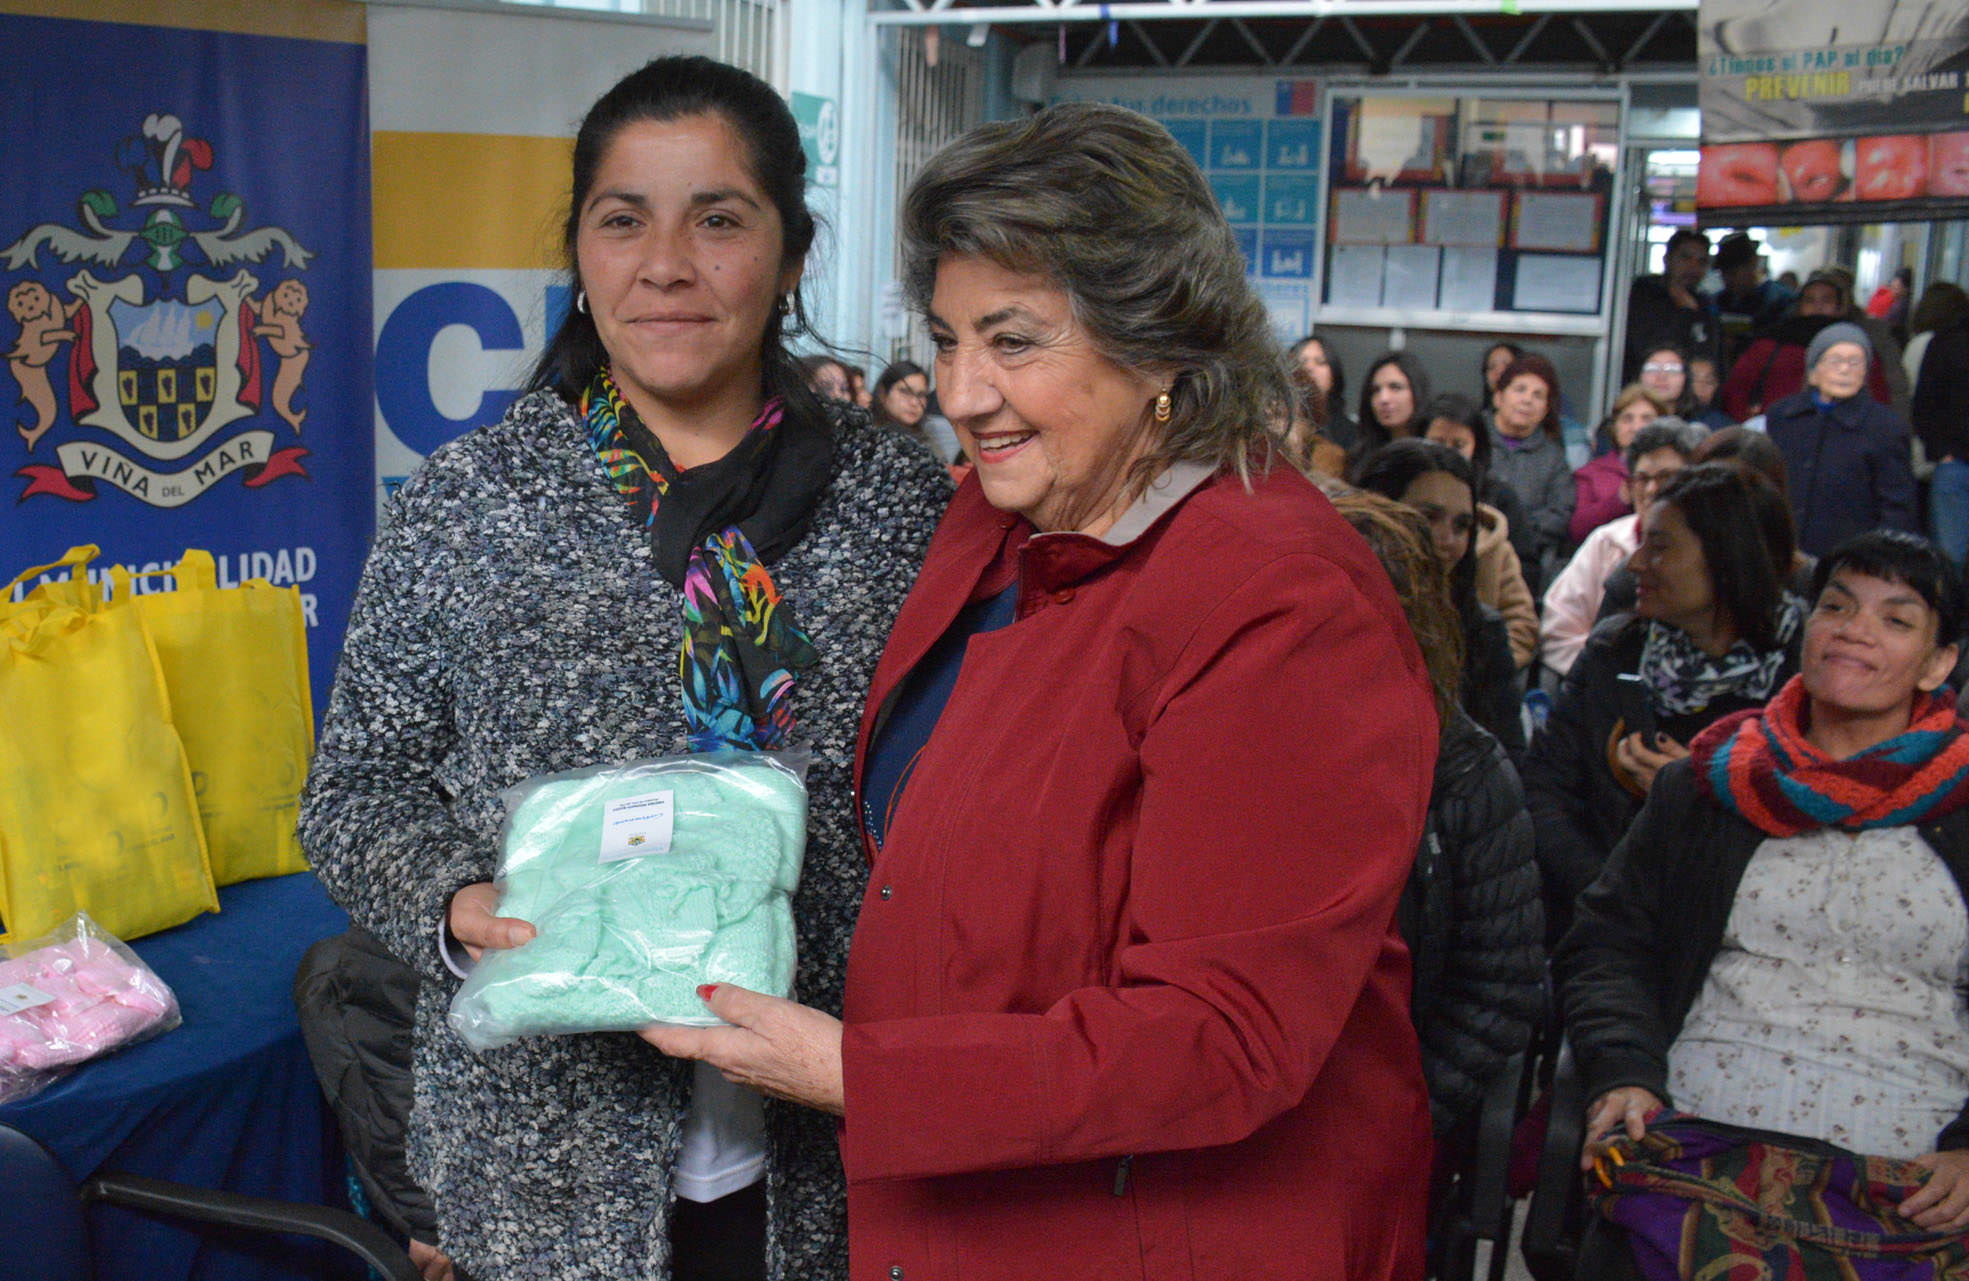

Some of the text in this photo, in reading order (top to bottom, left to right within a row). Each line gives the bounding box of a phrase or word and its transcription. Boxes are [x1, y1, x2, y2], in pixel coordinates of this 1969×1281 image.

[1709, 55, 1775, 76] ¿Tienes
[1803, 51, 1838, 70] PAP
[1845, 49, 1860, 68] al
[1745, 72, 1851, 101] PREVENIR
[1152, 94, 1252, 114] derechos
[81, 440, 255, 498] VIÑA DEL MAR
